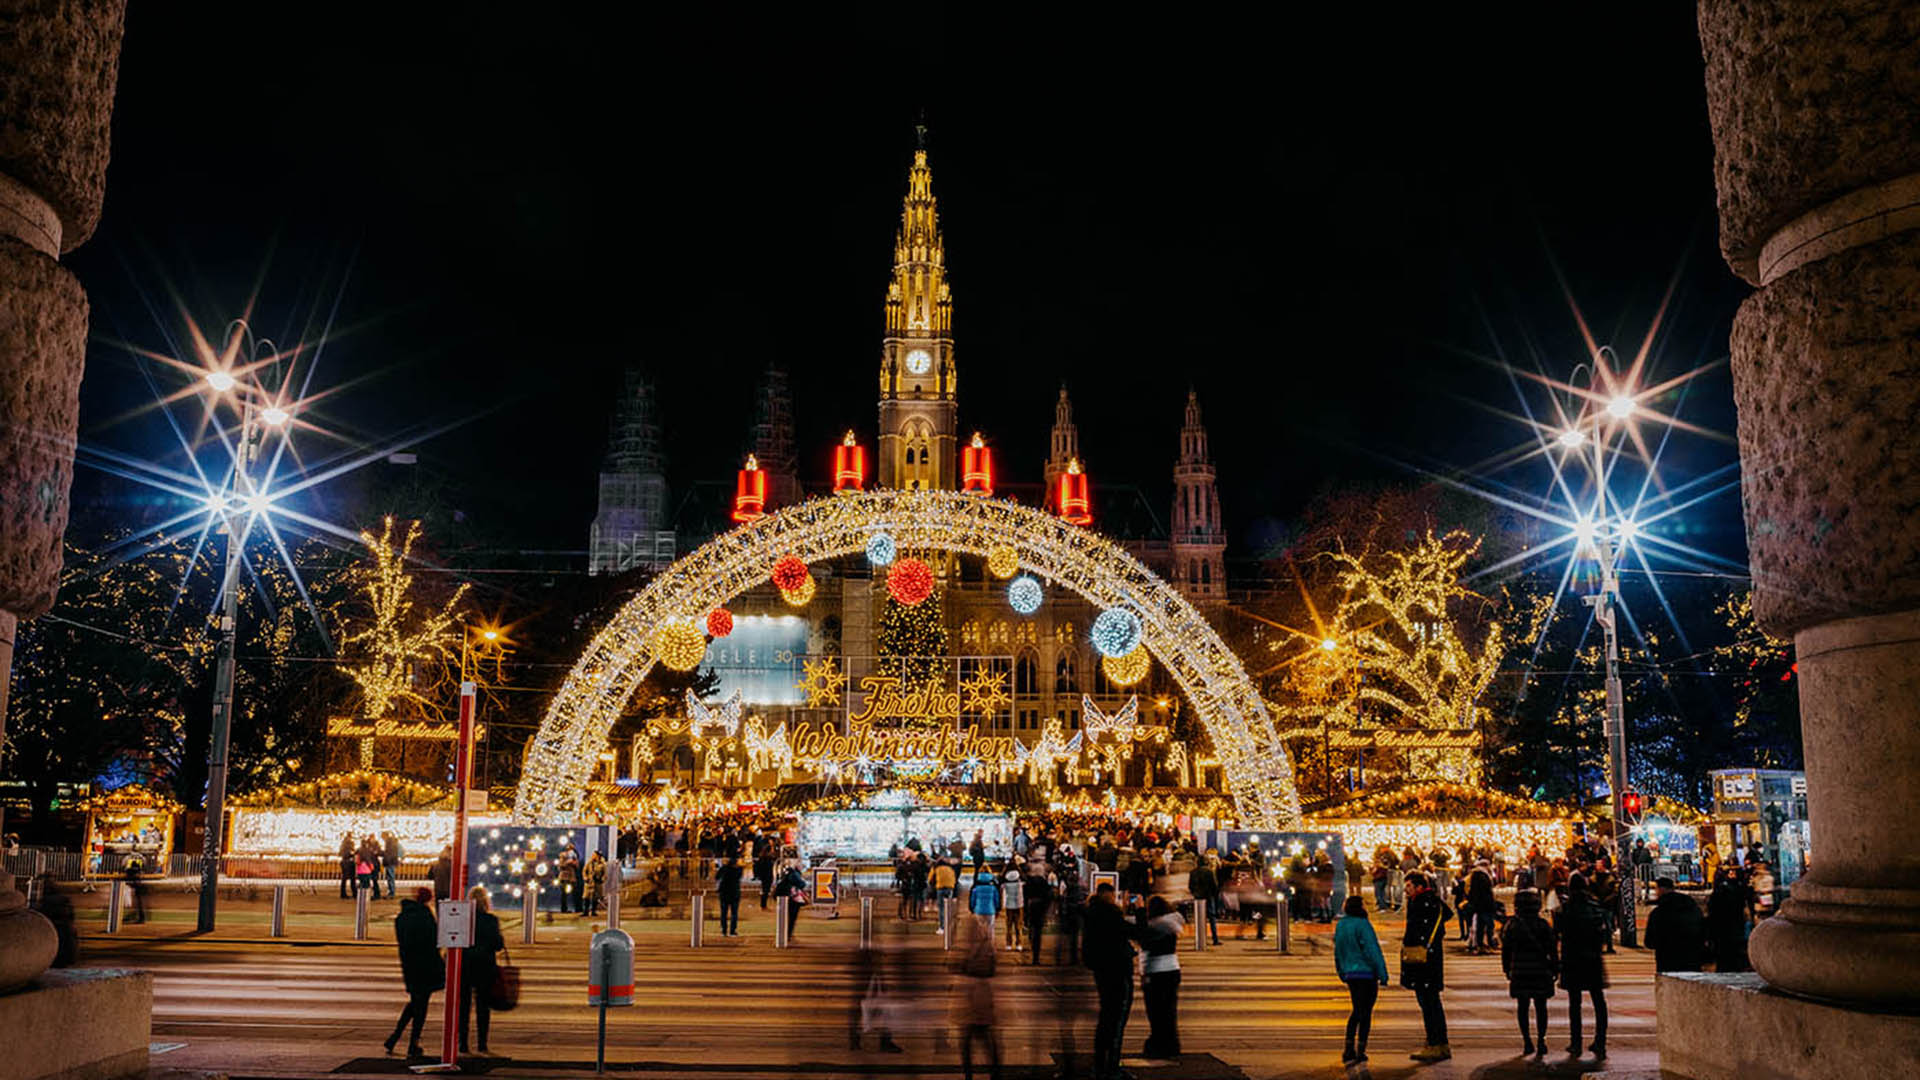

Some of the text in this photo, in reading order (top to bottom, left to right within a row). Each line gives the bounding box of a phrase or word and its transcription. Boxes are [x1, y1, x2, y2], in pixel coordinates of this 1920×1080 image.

[848, 677, 960, 723] Frohe
[328, 718, 375, 736] Wiener
[791, 722, 1015, 762] Weihnachten
[1328, 730, 1482, 746] Wiener Christkindlmarkt
[110, 798, 151, 806] MARONI
